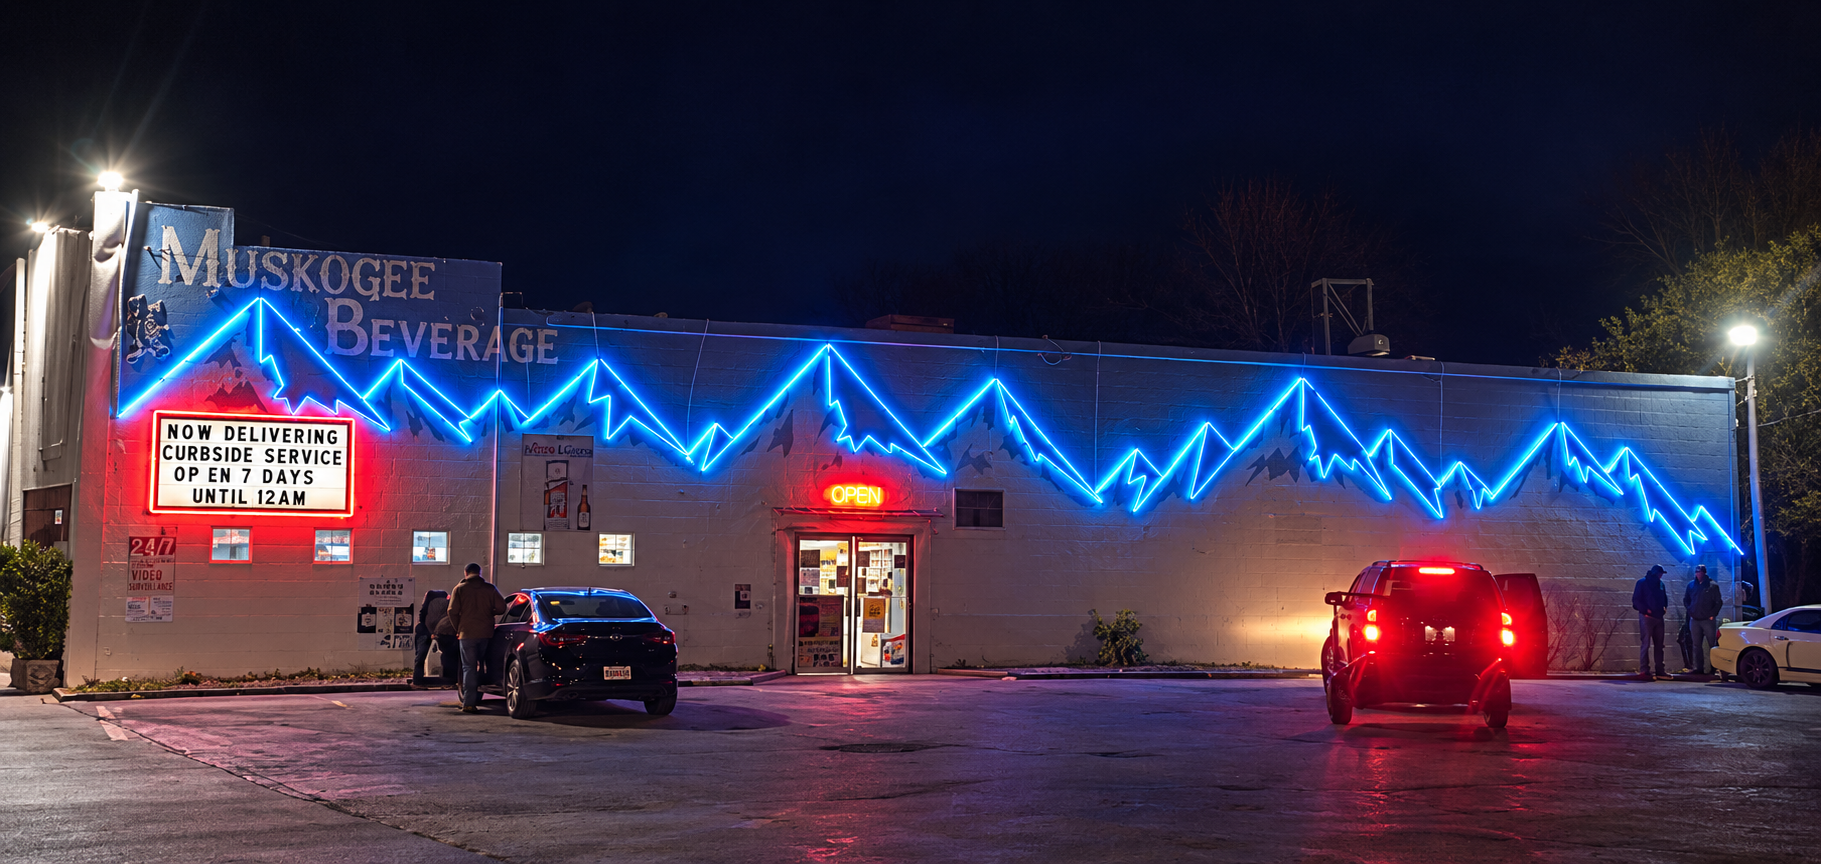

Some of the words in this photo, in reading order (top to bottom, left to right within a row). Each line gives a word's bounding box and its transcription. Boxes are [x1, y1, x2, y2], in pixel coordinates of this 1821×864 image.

[157, 225, 436, 301] MUSKOGEE
[324, 297, 559, 365] BEVERAGE
[167, 424, 212, 440] NOW
[224, 426, 338, 443] DELIVERING
[162, 445, 253, 462] CURBSIDE
[264, 448, 342, 465] SERVICE
[242, 468, 252, 483] 7
[262, 469, 314, 485] DAYS
[192, 488, 247, 504] UNTIL
[257, 489, 306, 506] 12AM
[831, 485, 881, 504] OPEN
[130, 537, 175, 556] 24/7
[131, 569, 163, 581] VIDEO
